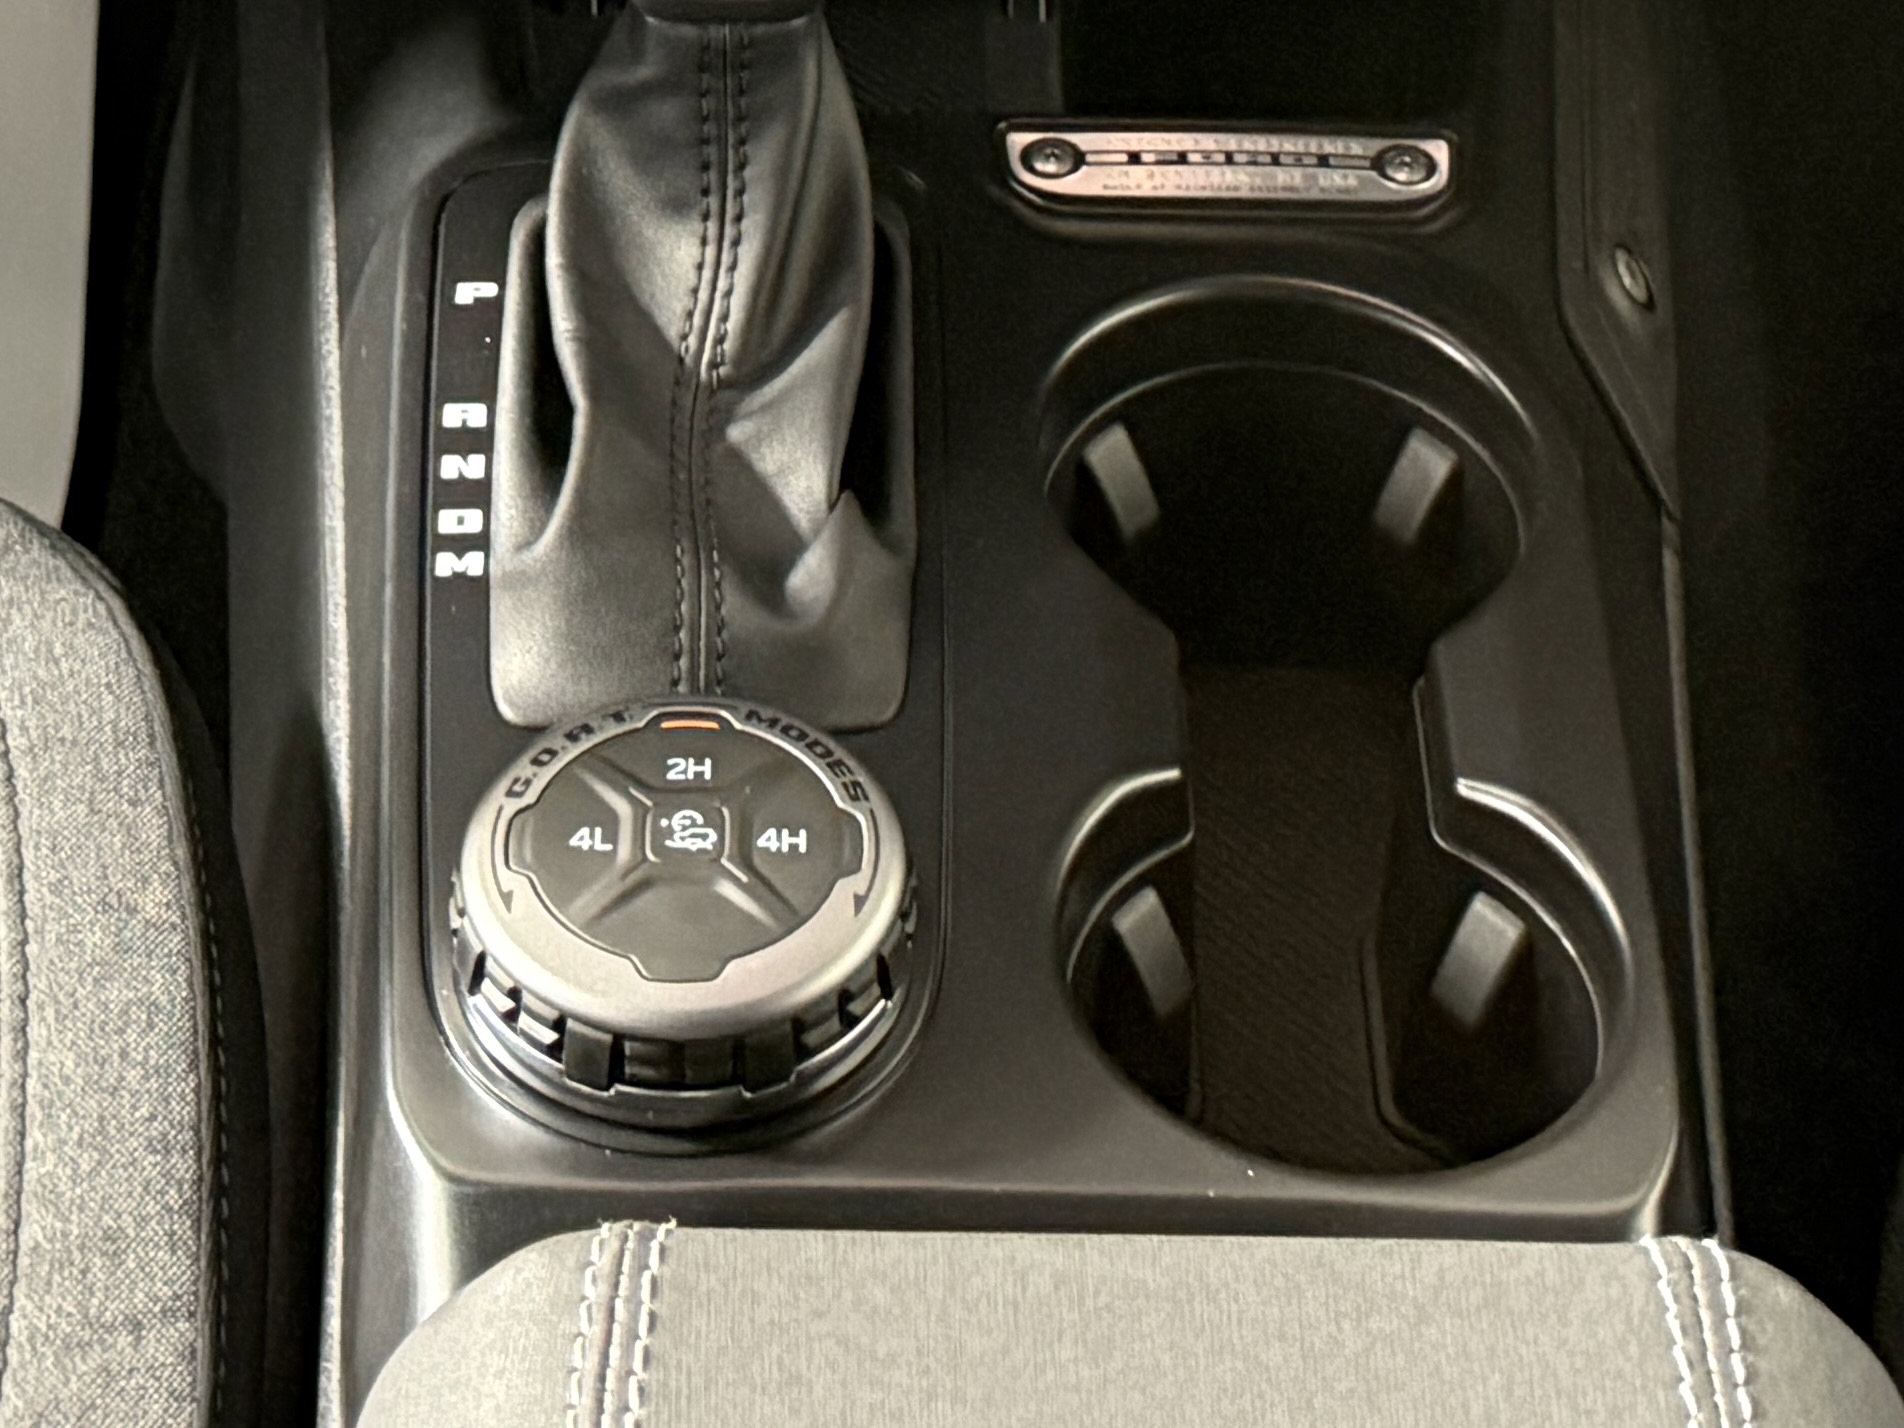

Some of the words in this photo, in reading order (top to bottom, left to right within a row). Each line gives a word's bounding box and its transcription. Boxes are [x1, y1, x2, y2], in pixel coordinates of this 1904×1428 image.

[454, 282, 499, 305] P
[440, 454, 486, 479] N
[434, 551, 484, 577] M
[746, 709, 870, 803] MODES
[666, 757, 712, 781] 2H
[568, 827, 614, 853] 4L
[756, 829, 808, 853] 4H
